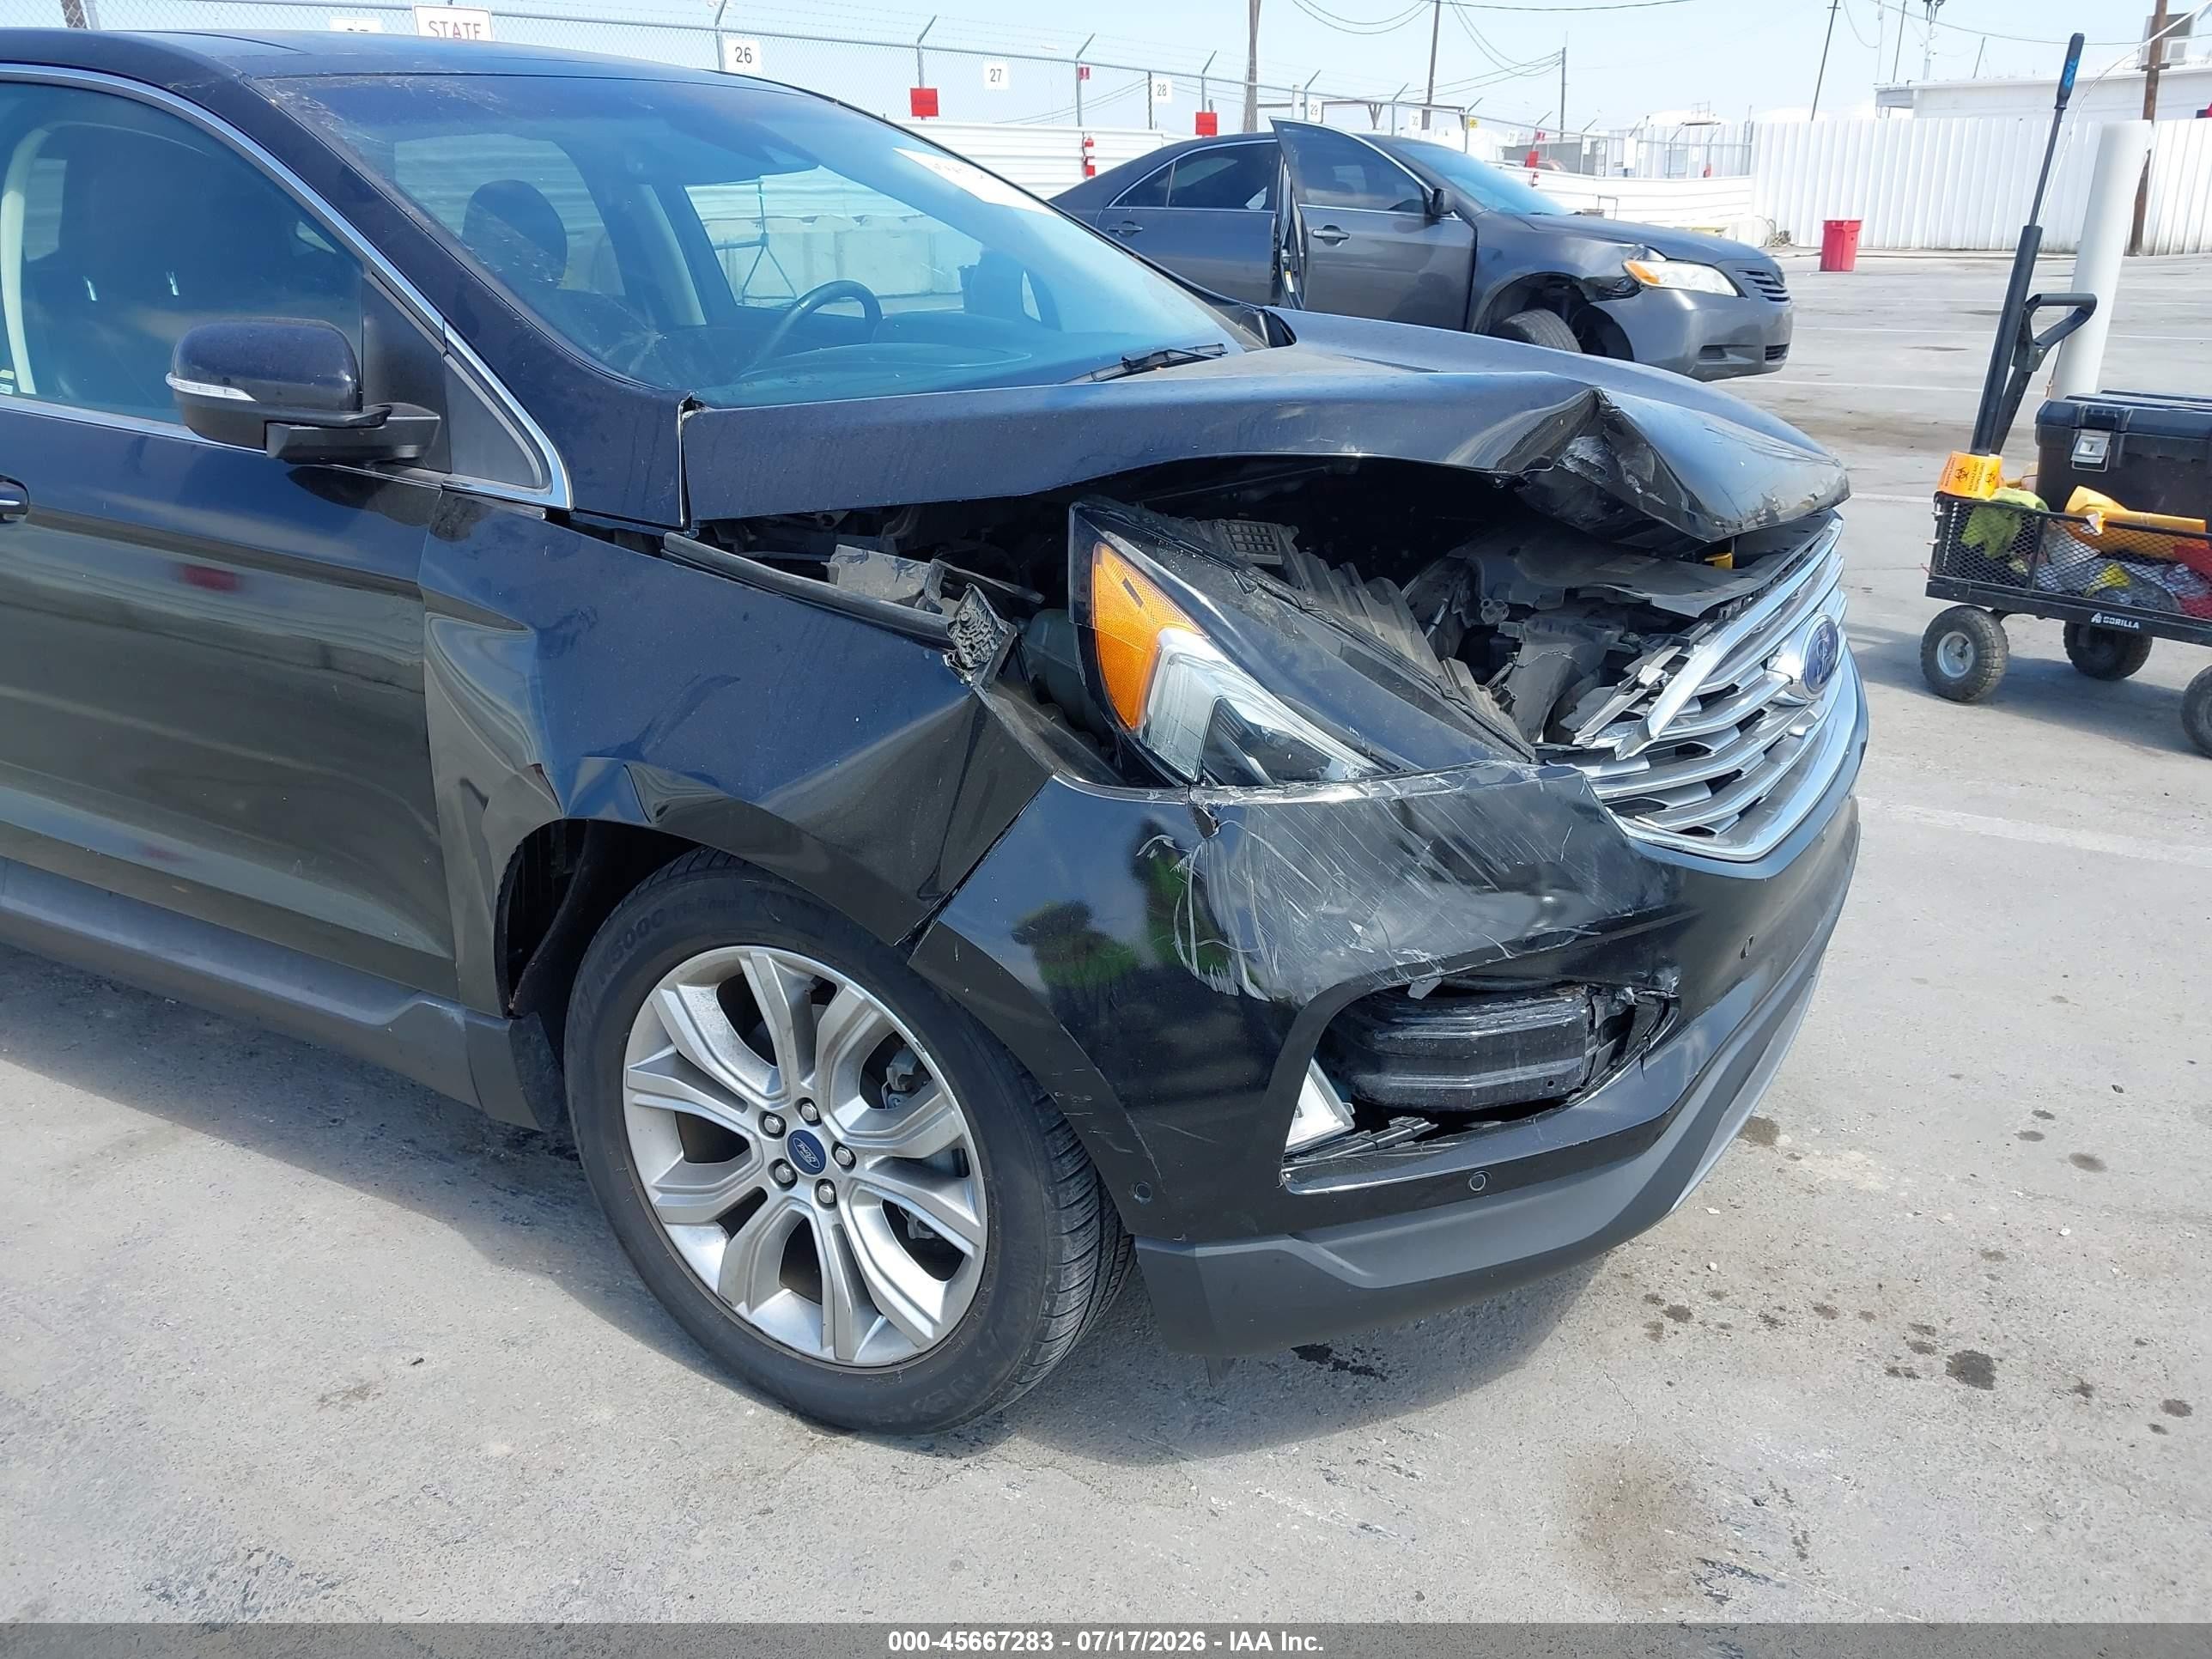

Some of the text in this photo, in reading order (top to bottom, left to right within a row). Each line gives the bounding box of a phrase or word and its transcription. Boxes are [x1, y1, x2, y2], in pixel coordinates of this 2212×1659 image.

[735, 46, 752, 64] 26
[989, 69, 1002, 82] 27
[1157, 84, 1166, 96] 28
[2103, 616, 2139, 629] GORILLA
